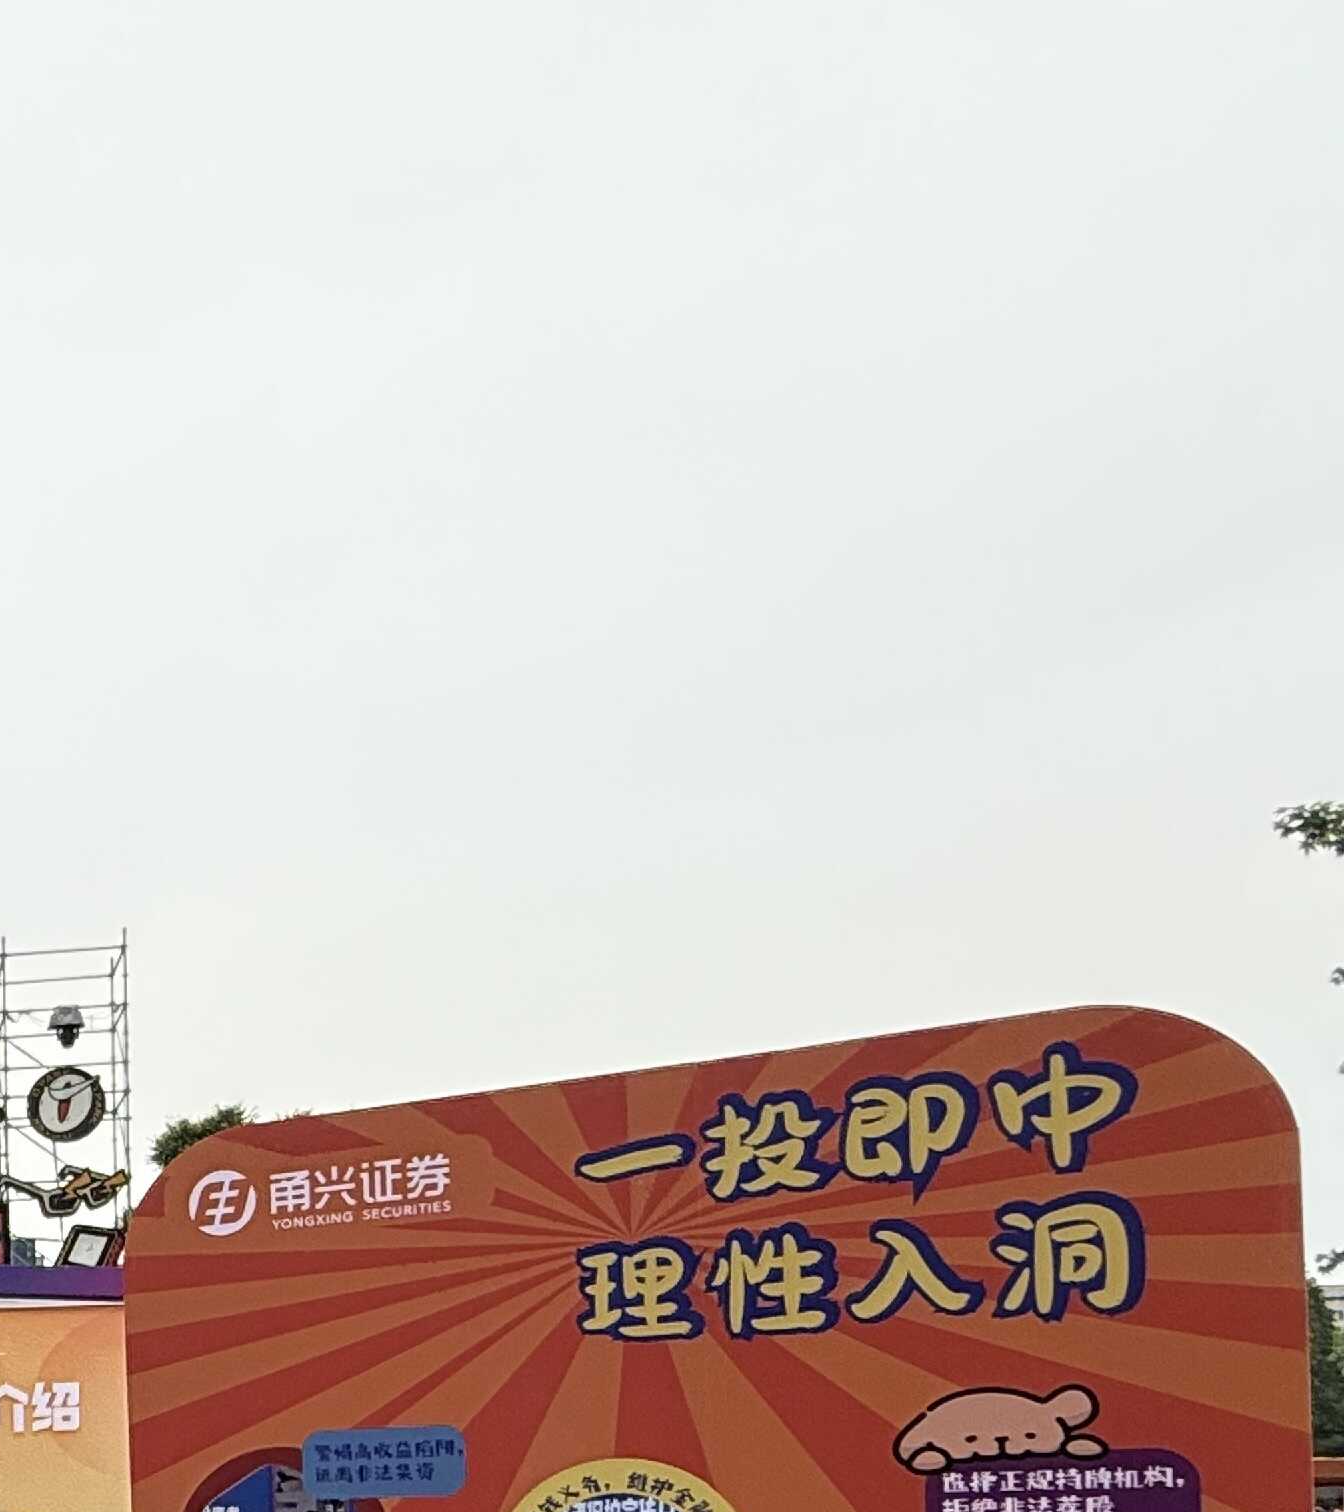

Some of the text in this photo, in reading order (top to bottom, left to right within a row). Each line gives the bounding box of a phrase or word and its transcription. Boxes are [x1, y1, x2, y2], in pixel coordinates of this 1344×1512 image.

[577, 1045, 1134, 1200] 一投即中
[269, 1153, 451, 1215] 甬兴证券
[272, 1201, 452, 1230] YONGXING SECURITIES
[578, 1197, 1138, 1339] 理性入洞
[942, 1465, 1185, 1494] 选择正规持牌机构，
